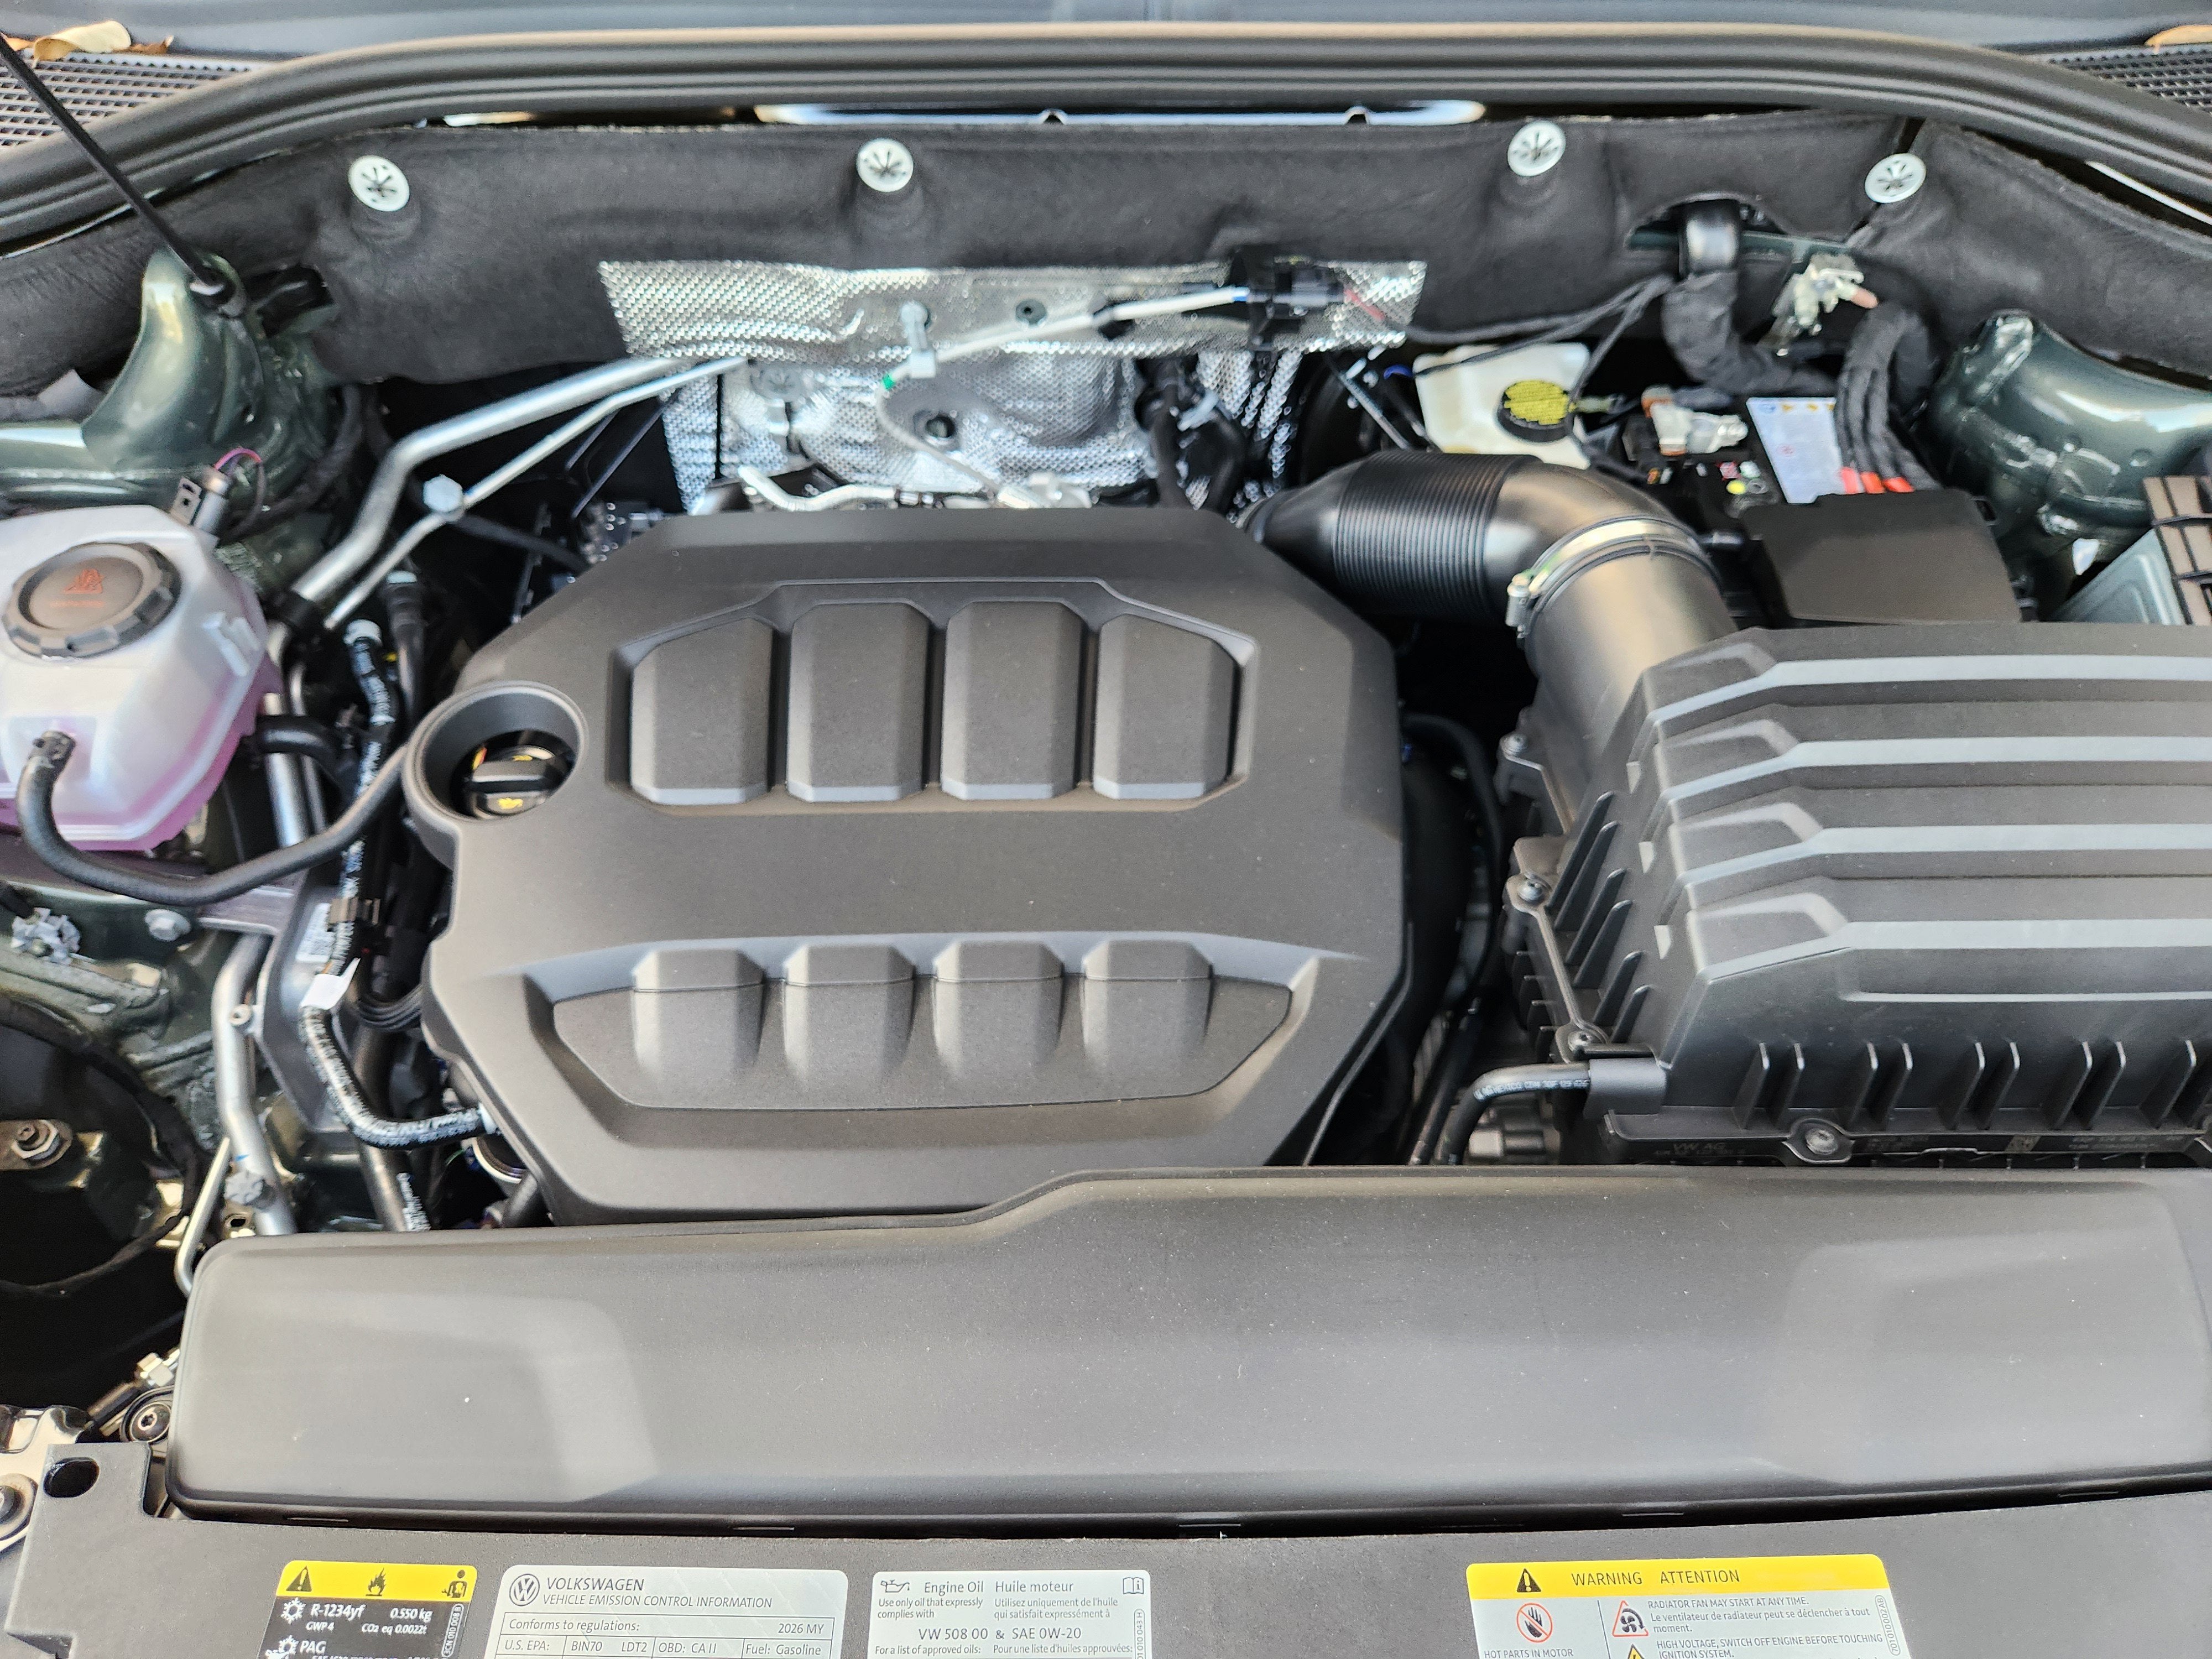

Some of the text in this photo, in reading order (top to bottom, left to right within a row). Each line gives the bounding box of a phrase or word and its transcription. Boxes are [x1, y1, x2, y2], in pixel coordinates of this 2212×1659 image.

[1571, 1569, 1740, 1585] WARNING ATTENTION
[547, 1577, 644, 1591] VOLKSWAGEN
[924, 1580, 984, 1596] Engine Oil
[995, 1580, 1074, 1593] Huile moteur
[543, 1594, 773, 1608] VEHICLE EMISSION CONTROL INFORMATION
[879, 1597, 983, 1609] Use only oil that expressly
[995, 1597, 1118, 1609] Utilisez uniquement de l'huile
[1648, 1597, 1809, 1609] RADIATOR FAN MAY START AT ANY TIME.
[311, 1604, 433, 1623] R-1234yf 0.550 kg
[878, 1609, 934, 1620] complies with
[994, 1609, 1110, 1621] qui satisfait expressément à
[1651, 1613, 1661, 1622] Le
[1662, 1612, 1710, 1622] ventilateur
[1711, 1611, 1721, 1620] de
[1724, 1610, 1762, 1620] radiateur
[1765, 1610, 1783, 1621] peut
[1797, 1608, 1843, 1618] déclencher
[1845, 1608, 1850, 1616] à
[306, 1622, 327, 1631] GWP
[327, 1623, 335, 1631] 4
[382, 1626, 393, 1636] eq
[509, 1619, 640, 1633] Conforms to regulations:
[778, 1623, 824, 1634] 2026 MY
[1653, 1624, 1693, 1633] moment.
[448, 1626, 457, 1640] 010
[919, 1627, 1081, 1640] VW 508 00 & SAE 0W-20
[300, 1641, 327, 1654] PAG
[505, 1640, 550, 1651] U.S. EPA:
[571, 1641, 647, 1652] BIN70 LDT2
[659, 1642, 685, 1653] OBD:
[691, 1643, 705, 1653] CA
[1657, 1634, 1883, 1649] HIGH VOLTAGE, SWITCH OFF ENGINE BEFORE TOUCHING
[746, 1644, 821, 1655] Fuel: Gasoline
[875, 1646, 889, 1655] For
[898, 1645, 910, 1654] list
[912, 1645, 921, 1655] of
[922, 1645, 962, 1656] approved
[964, 1645, 981, 1654] oils:
[993, 1645, 1012, 1653] Pour
[1031, 1644, 1048, 1653] liste
[1050, 1644, 1082, 1653] d'huiles
[1083, 1644, 1133, 1655] approuvées:
[1484, 1648, 1574, 1659] HOT PARTS IN MOTOR
[1659, 1648, 1734, 1659] IGNITION SYSTEM.
